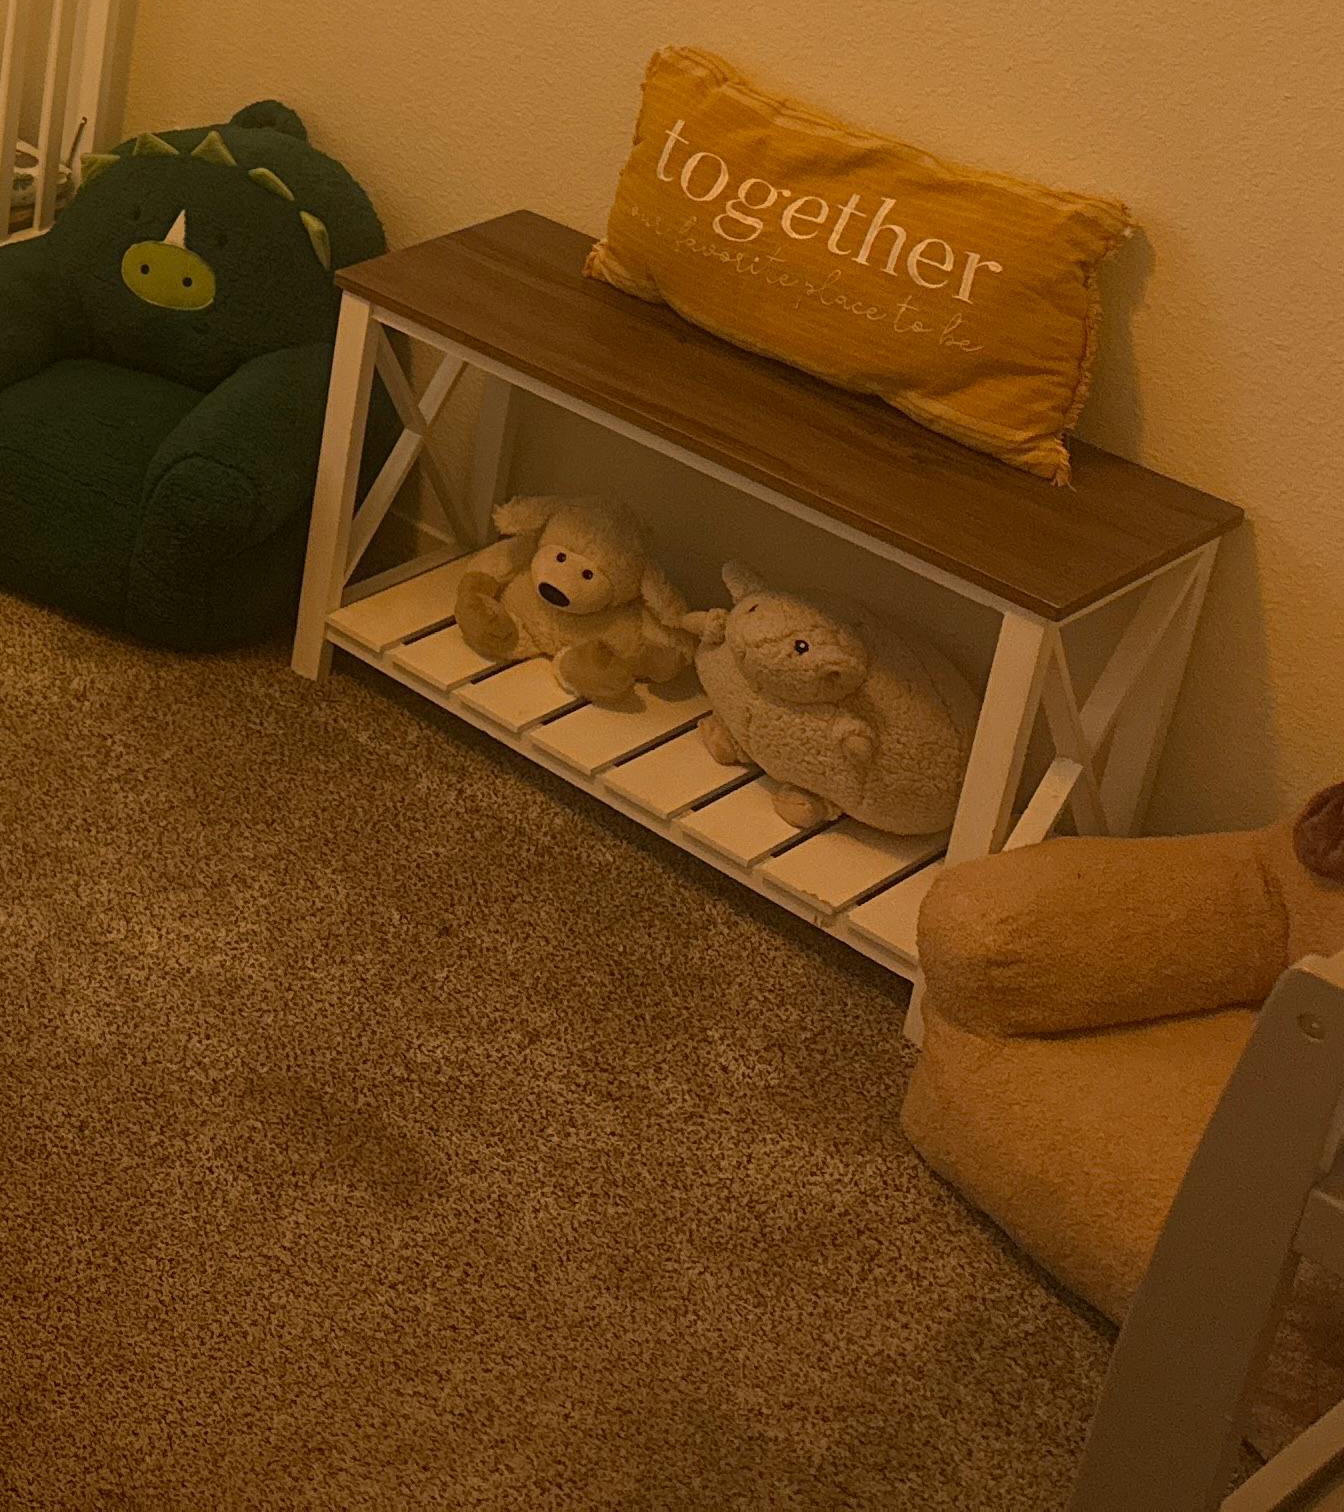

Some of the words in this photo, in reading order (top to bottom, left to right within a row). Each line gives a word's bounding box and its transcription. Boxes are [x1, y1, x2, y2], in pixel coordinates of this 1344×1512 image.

[657, 120, 1003, 304] together
[893, 295, 933, 333] to
[939, 312, 985, 353] be
